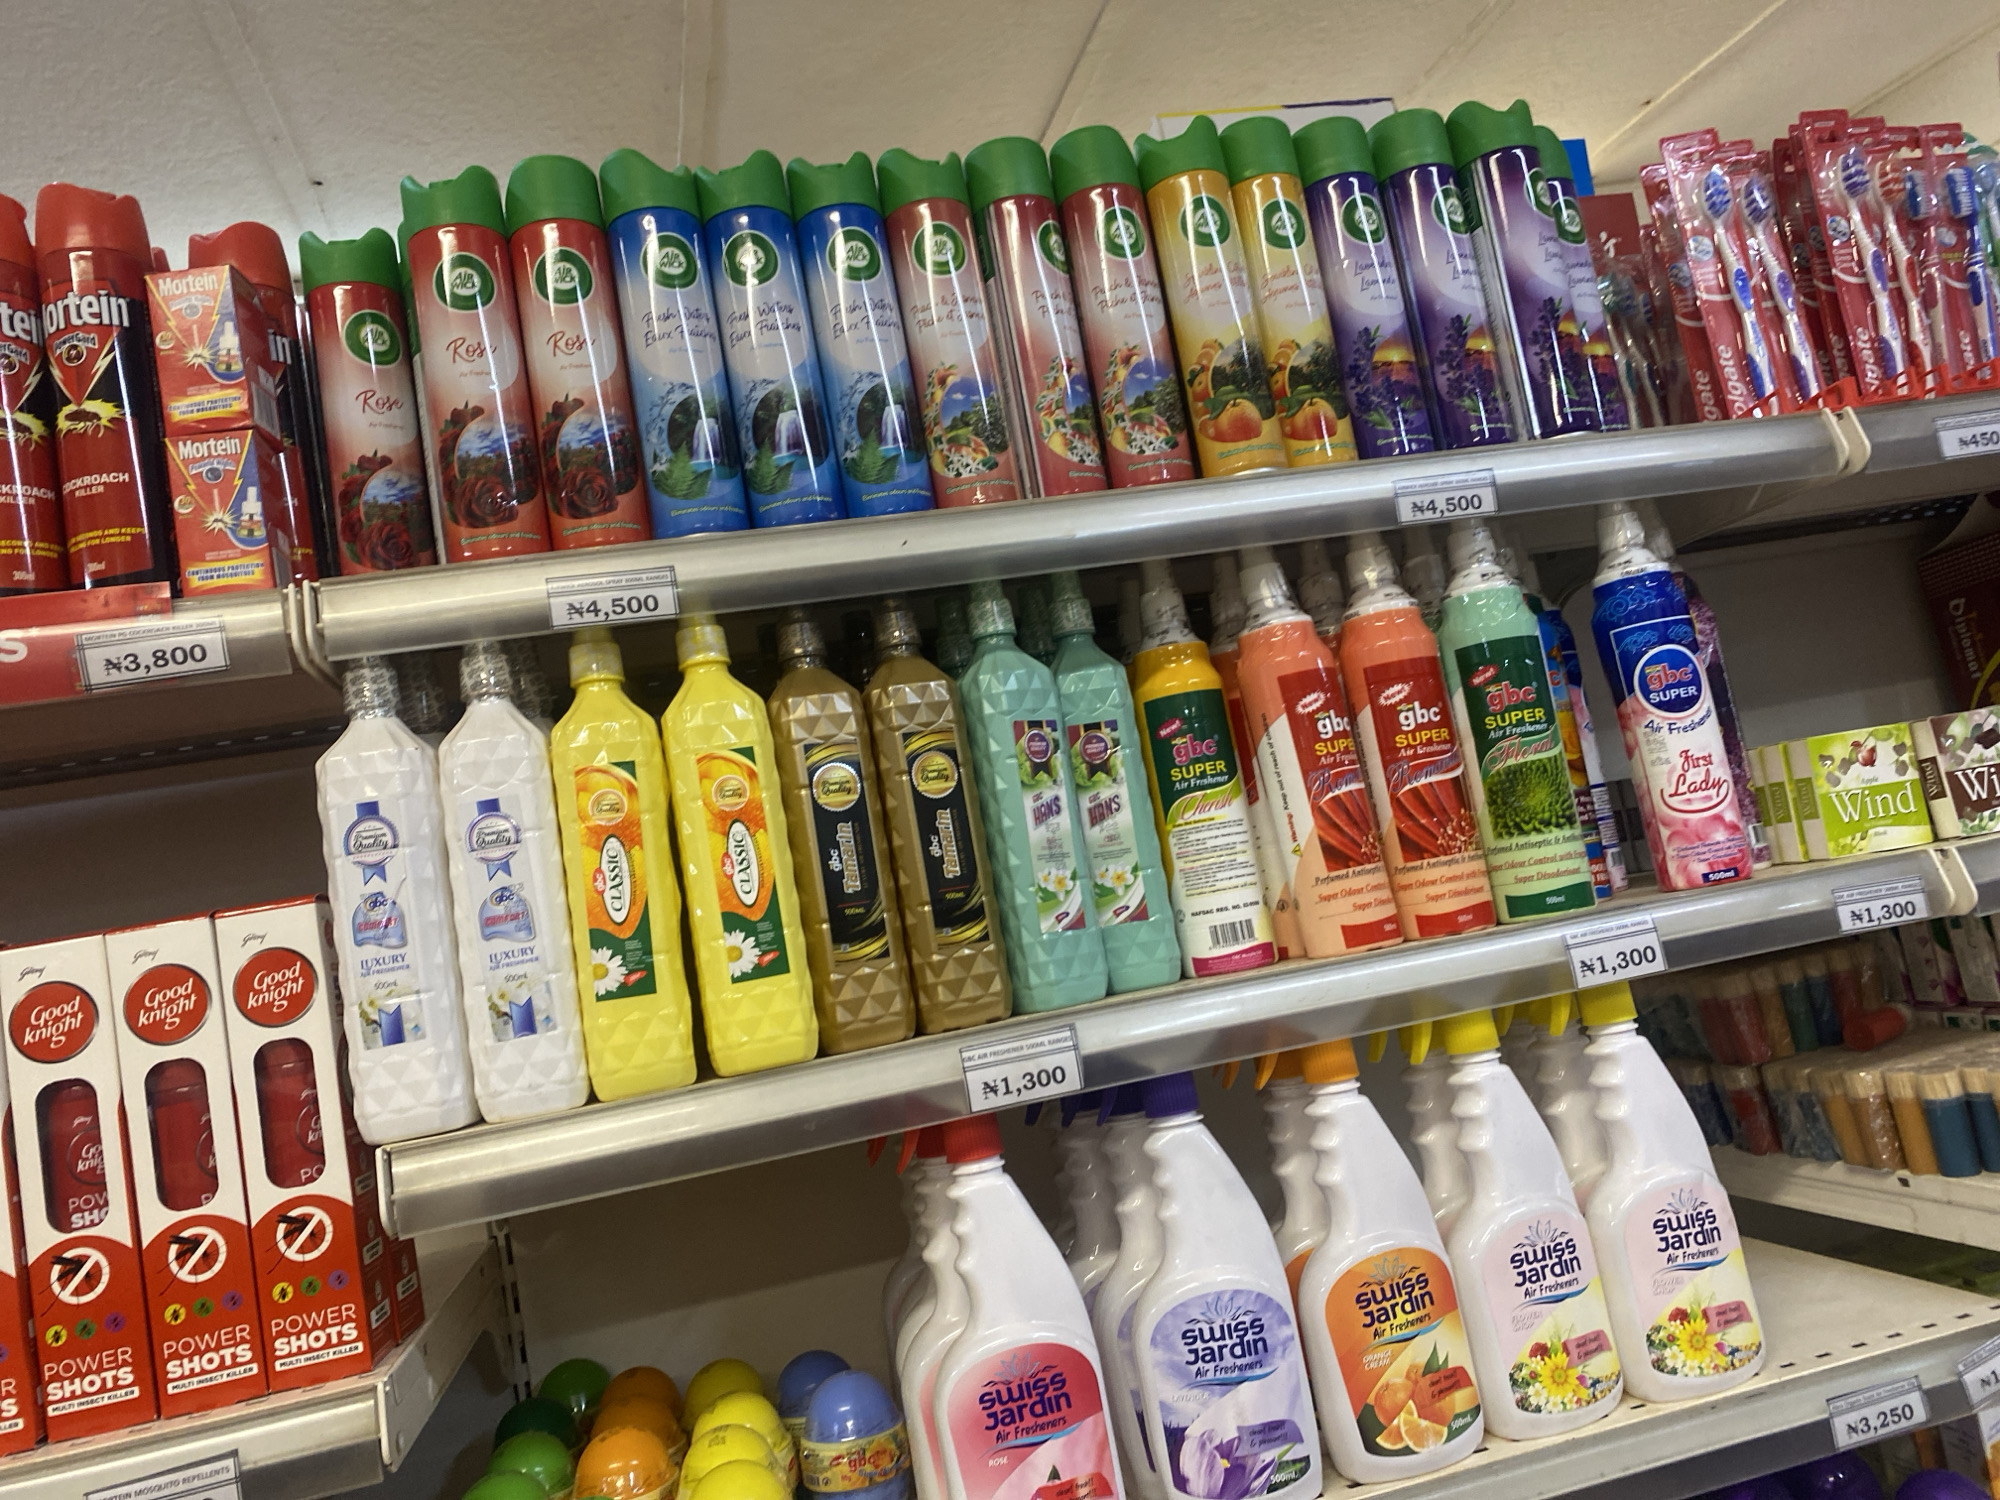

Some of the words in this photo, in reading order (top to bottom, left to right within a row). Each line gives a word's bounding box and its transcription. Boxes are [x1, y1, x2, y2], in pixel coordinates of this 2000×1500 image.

[158, 273, 218, 297] Mortein
[1718, 344, 1747, 420] olgate
[355, 389, 404, 415] Rose
[178, 436, 241, 460] Mortein
[75, 485, 104, 498] KILLER
[186, 566, 226, 577] CONTINUOUS
[227, 561, 264, 572] PROTECTION
[197, 574, 215, 582] FROM
[1472, 666, 1495, 686] New!
[1647, 663, 1692, 691] gbc
[1300, 694, 1323, 710] New!
[1381, 684, 1411, 703] New!
[1486, 680, 1537, 713] gbc
[1649, 685, 1699, 704] SUPER
[1399, 701, 1442, 731] gbc
[1484, 707, 1547, 730] SUPER
[1159, 719, 1182, 738] New!
[1487, 727, 1505, 740] Air
[1505, 720, 1549, 736] Freshener
[1644, 719, 1663, 734] Air
[1314, 739, 1354, 756] SUPE
[1395, 728, 1450, 748] SUPER
[1172, 733, 1217, 765] gbc
[1399, 746, 1414, 758] Air
[1486, 735, 1555, 772] Floral
[1270, 750, 1280, 770] reach
[1318, 755, 1333, 766] Air
[1679, 748, 1714, 774] First
[920, 766, 949, 776] Premium
[920, 773, 950, 783] Quality
[1170, 759, 1228, 782] SUPER
[1921, 762, 1939, 797] Wind
[821, 778, 850, 788] Premium
[821, 785, 852, 796] Quality
[1173, 780, 1189, 792] Air
[1190, 773, 1229, 789] Freshener
[1277, 779, 1285, 791] out
[1668, 772, 1728, 799] Lady
[1955, 766, 2000, 801] Wi
[1033, 794, 1062, 829] HANS
[1087, 794, 1121, 829] HANS
[1175, 791, 1233, 823] Cherish
[1280, 792, 1290, 811] Keep
[1828, 781, 1918, 824] Wind
[352, 838, 389, 852] Quality
[475, 833, 511, 848] Quality
[928, 834, 942, 858] gbc
[936, 807, 962, 879] Tamarin
[1514, 838, 1553, 851] Antiseptic
[722, 856, 735, 876] gbc
[731, 830, 752, 895] CLASSIC
[828, 848, 840, 872] gbc
[837, 821, 862, 894] Tamarin
[1394, 864, 1424, 875] Perfumed
[1425, 857, 1460, 871] Antiseptic
[1504, 859, 1526, 870] Odour
[1527, 855, 1557, 866] Control
[593, 872, 606, 892] gbc
[606, 847, 624, 912] CLASSIC
[1314, 870, 1350, 886] Perfumed
[1415, 876, 1439, 889] Odour
[1439, 871, 1465, 884] Control
[1513, 874, 1536, 885] Super
[1708, 869, 1735, 881] 500ml
[1318, 891, 1339, 902] Super
[1340, 886, 1364, 898] Odour
[1425, 892, 1446, 902] Super
[369, 897, 388, 912] gbc
[1352, 901, 1373, 912] Super
[483, 911, 527, 928] COMFORT
[360, 951, 407, 970] LUXURY
[489, 945, 536, 964] LUXURY
[501, 956, 539, 969] FRESHENER
[253, 961, 301, 991] Good
[371, 963, 410, 976] FRESHENER
[144, 977, 194, 1008] Good
[247, 976, 304, 1013] knight
[30, 996, 81, 1027] Good
[137, 993, 198, 1031] knight
[23, 1011, 84, 1049] knight
[977, 1052, 989, 1060] AIR
[989, 1046, 1025, 1058] FRESHENER
[1047, 1036, 1072, 1047] RANGES
[1667, 1252, 1679, 1265] Air
[1682, 1246, 1719, 1263] Fresheners
[1524, 1286, 1537, 1300] Air
[1539, 1276, 1579, 1295] Fresheners
[270, 1303, 357, 1336] POWER
[1373, 1326, 1386, 1341] Air
[1389, 1313, 1432, 1336] Fresheners
[162, 1324, 251, 1358] POWER
[273, 1322, 359, 1357] SHOTS
[43, 1346, 133, 1381] POWER
[166, 1343, 253, 1379] SHOTS
[279, 1357, 302, 1369] MULTI
[303, 1350, 331, 1364] INSECT
[332, 1344, 360, 1358] KILLER
[1362, 1349, 1392, 1364] ORANGE
[1364, 1358, 1391, 1371] CREAM
[172, 1379, 195, 1391] MULTI
[196, 1373, 225, 1386] INSECT
[226, 1366, 254, 1380] KILLER
[1194, 1368, 1210, 1380] Air
[1213, 1360, 1263, 1377] Fresheners
[46, 1366, 135, 1401] SHOTS
[51, 1401, 75, 1414] MULTI
[76, 1395, 105, 1408] INSECT
[107, 1389, 136, 1402] KILLER
[996, 1428, 1010, 1444] Air
[1014, 1416, 1067, 1440] Fresheners
[988, 1456, 1009, 1467] ROSE
[134, 1480, 181, 1497] MOSQUITO
[181, 1465, 231, 1485] REPELLENTS
